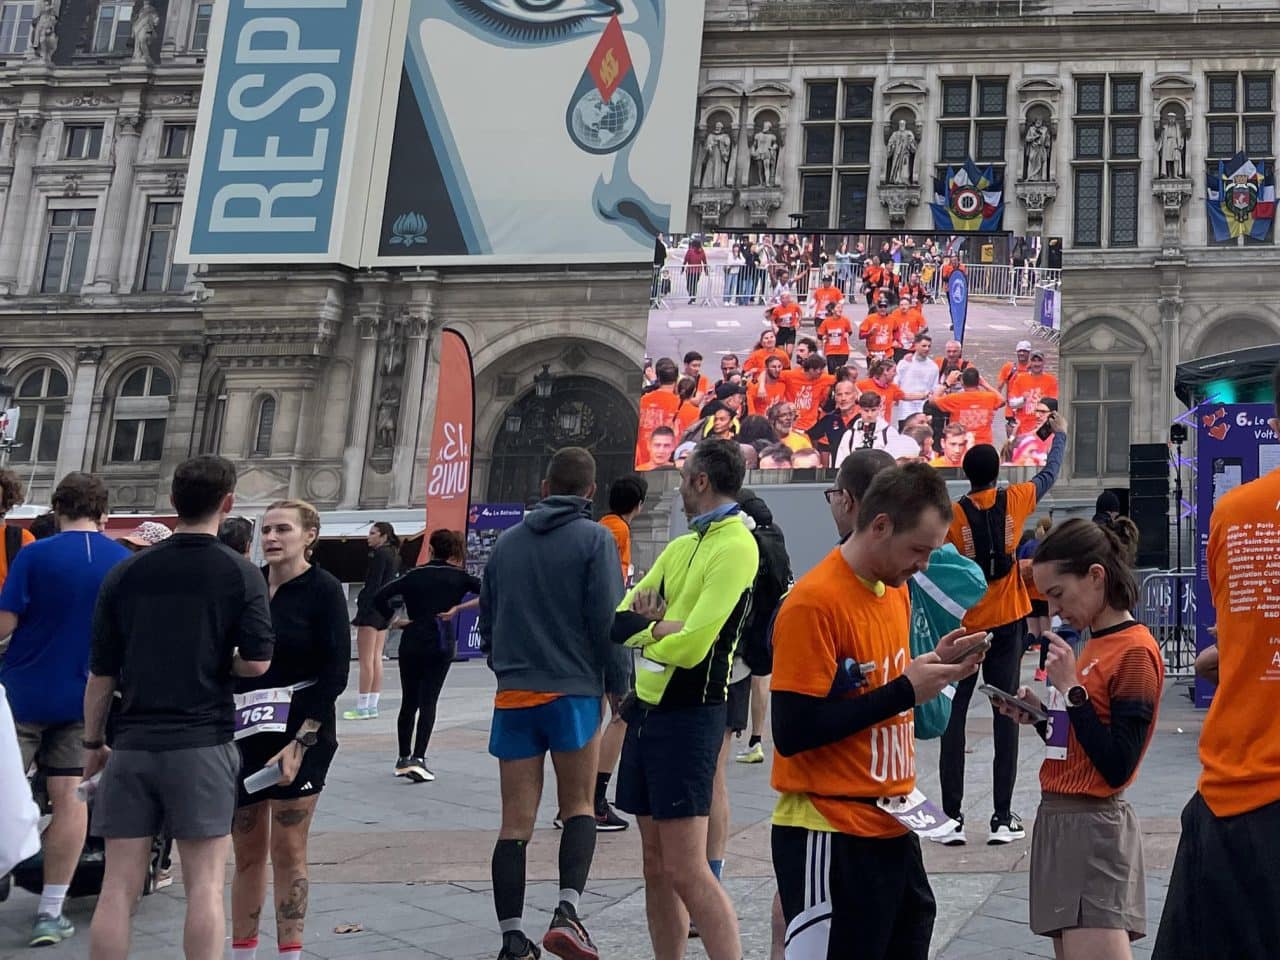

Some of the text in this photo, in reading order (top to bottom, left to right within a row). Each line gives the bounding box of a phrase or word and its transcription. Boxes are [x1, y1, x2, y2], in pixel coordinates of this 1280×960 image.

[1236, 412, 1264, 427] 6. Le
[241, 705, 274, 726] 762
